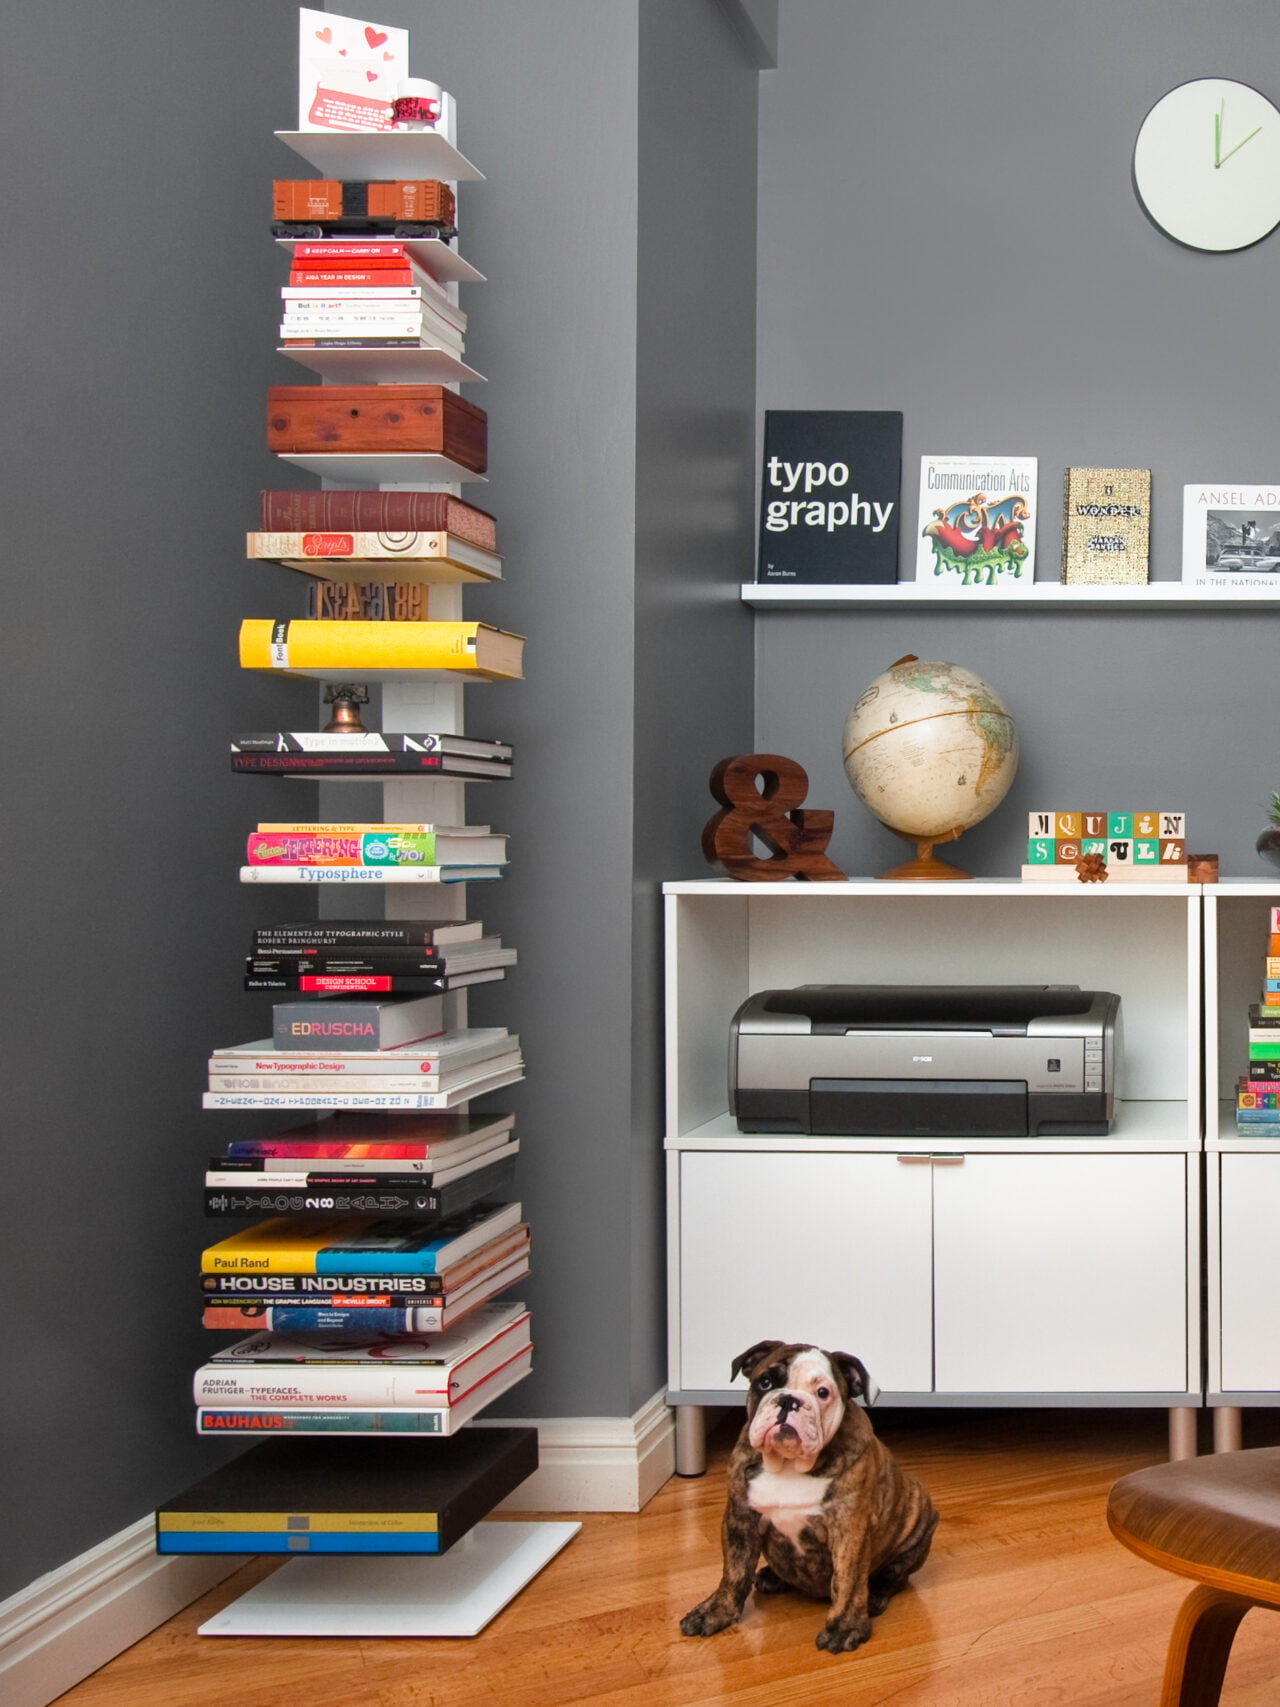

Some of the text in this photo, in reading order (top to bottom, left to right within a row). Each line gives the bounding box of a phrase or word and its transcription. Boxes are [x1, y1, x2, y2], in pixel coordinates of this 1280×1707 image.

[767, 456, 849, 493] typo
[928, 466, 1030, 492] Communication Arts
[1198, 492, 1246, 504] ANSEL
[765, 493, 894, 533] graphy
[1076, 504, 1142, 517] WONDER
[303, 534, 349, 556] Scripts
[298, 867, 383, 881] Typosphere
[273, 1063, 317, 1071] Typographic
[319, 1063, 345, 1071] Design
[214, 1258, 269, 1268] Paul Rand
[220, 1277, 426, 1291] HOUSE INDUSTRIES
[203, 1415, 282, 1428] BAUHAUS
